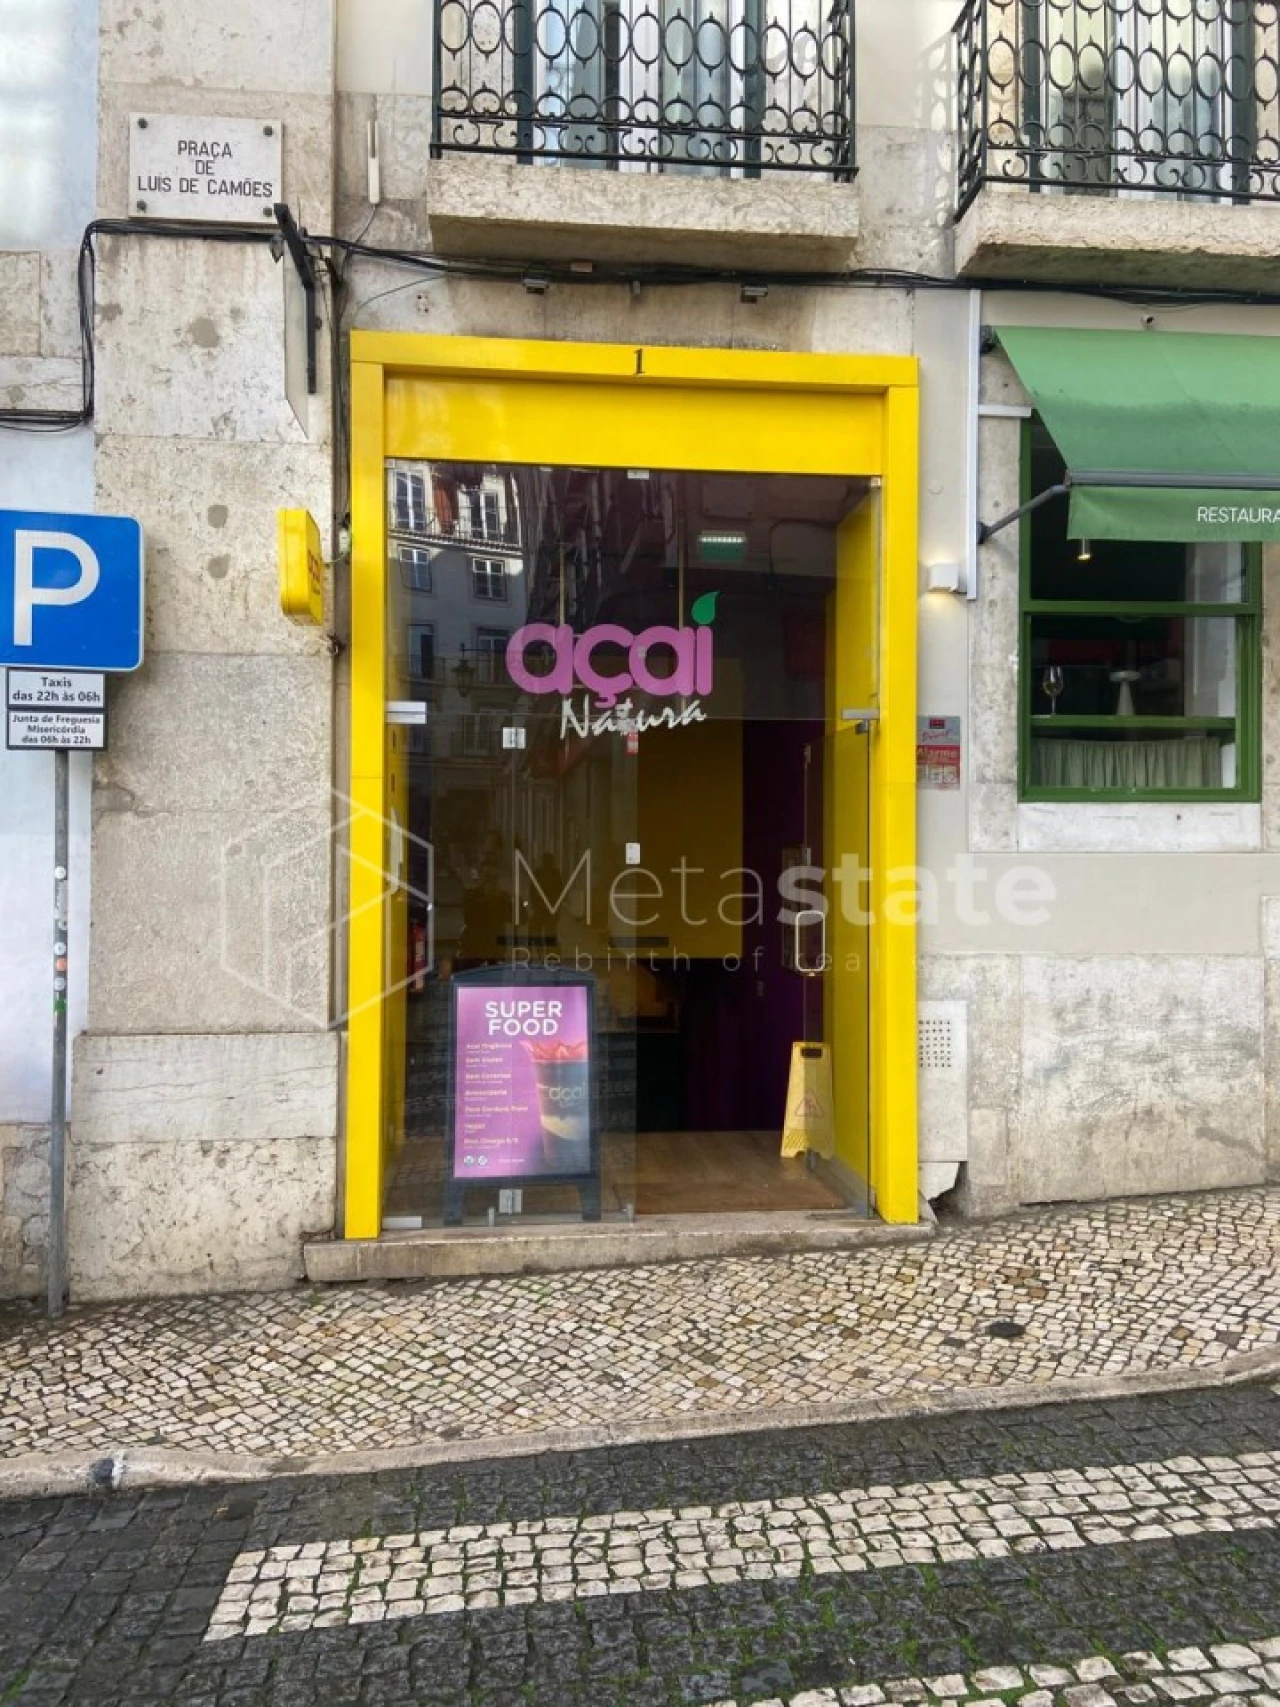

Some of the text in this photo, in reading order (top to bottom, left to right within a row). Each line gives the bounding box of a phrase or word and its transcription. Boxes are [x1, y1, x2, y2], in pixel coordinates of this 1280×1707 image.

[177, 140, 233, 158] PRAÇA
[195, 159, 216, 176] DE
[179, 178, 199, 194] DE
[207, 178, 273, 198] CAMÕES
[633, 348, 643, 374] 1
[14, 529, 100, 646] P
[40, 676, 72, 687] Taxis
[12, 689, 100, 702] das 22h às 06h
[12, 714, 100, 725] Junta de Freguesia
[560, 694, 707, 741] Natura
[28, 724, 86, 734] Misericórdia
[21, 735, 91, 744] das 06h às 22h
[485, 1000, 562, 1018] SUPER
[488, 1018, 558, 1036] FOOD
